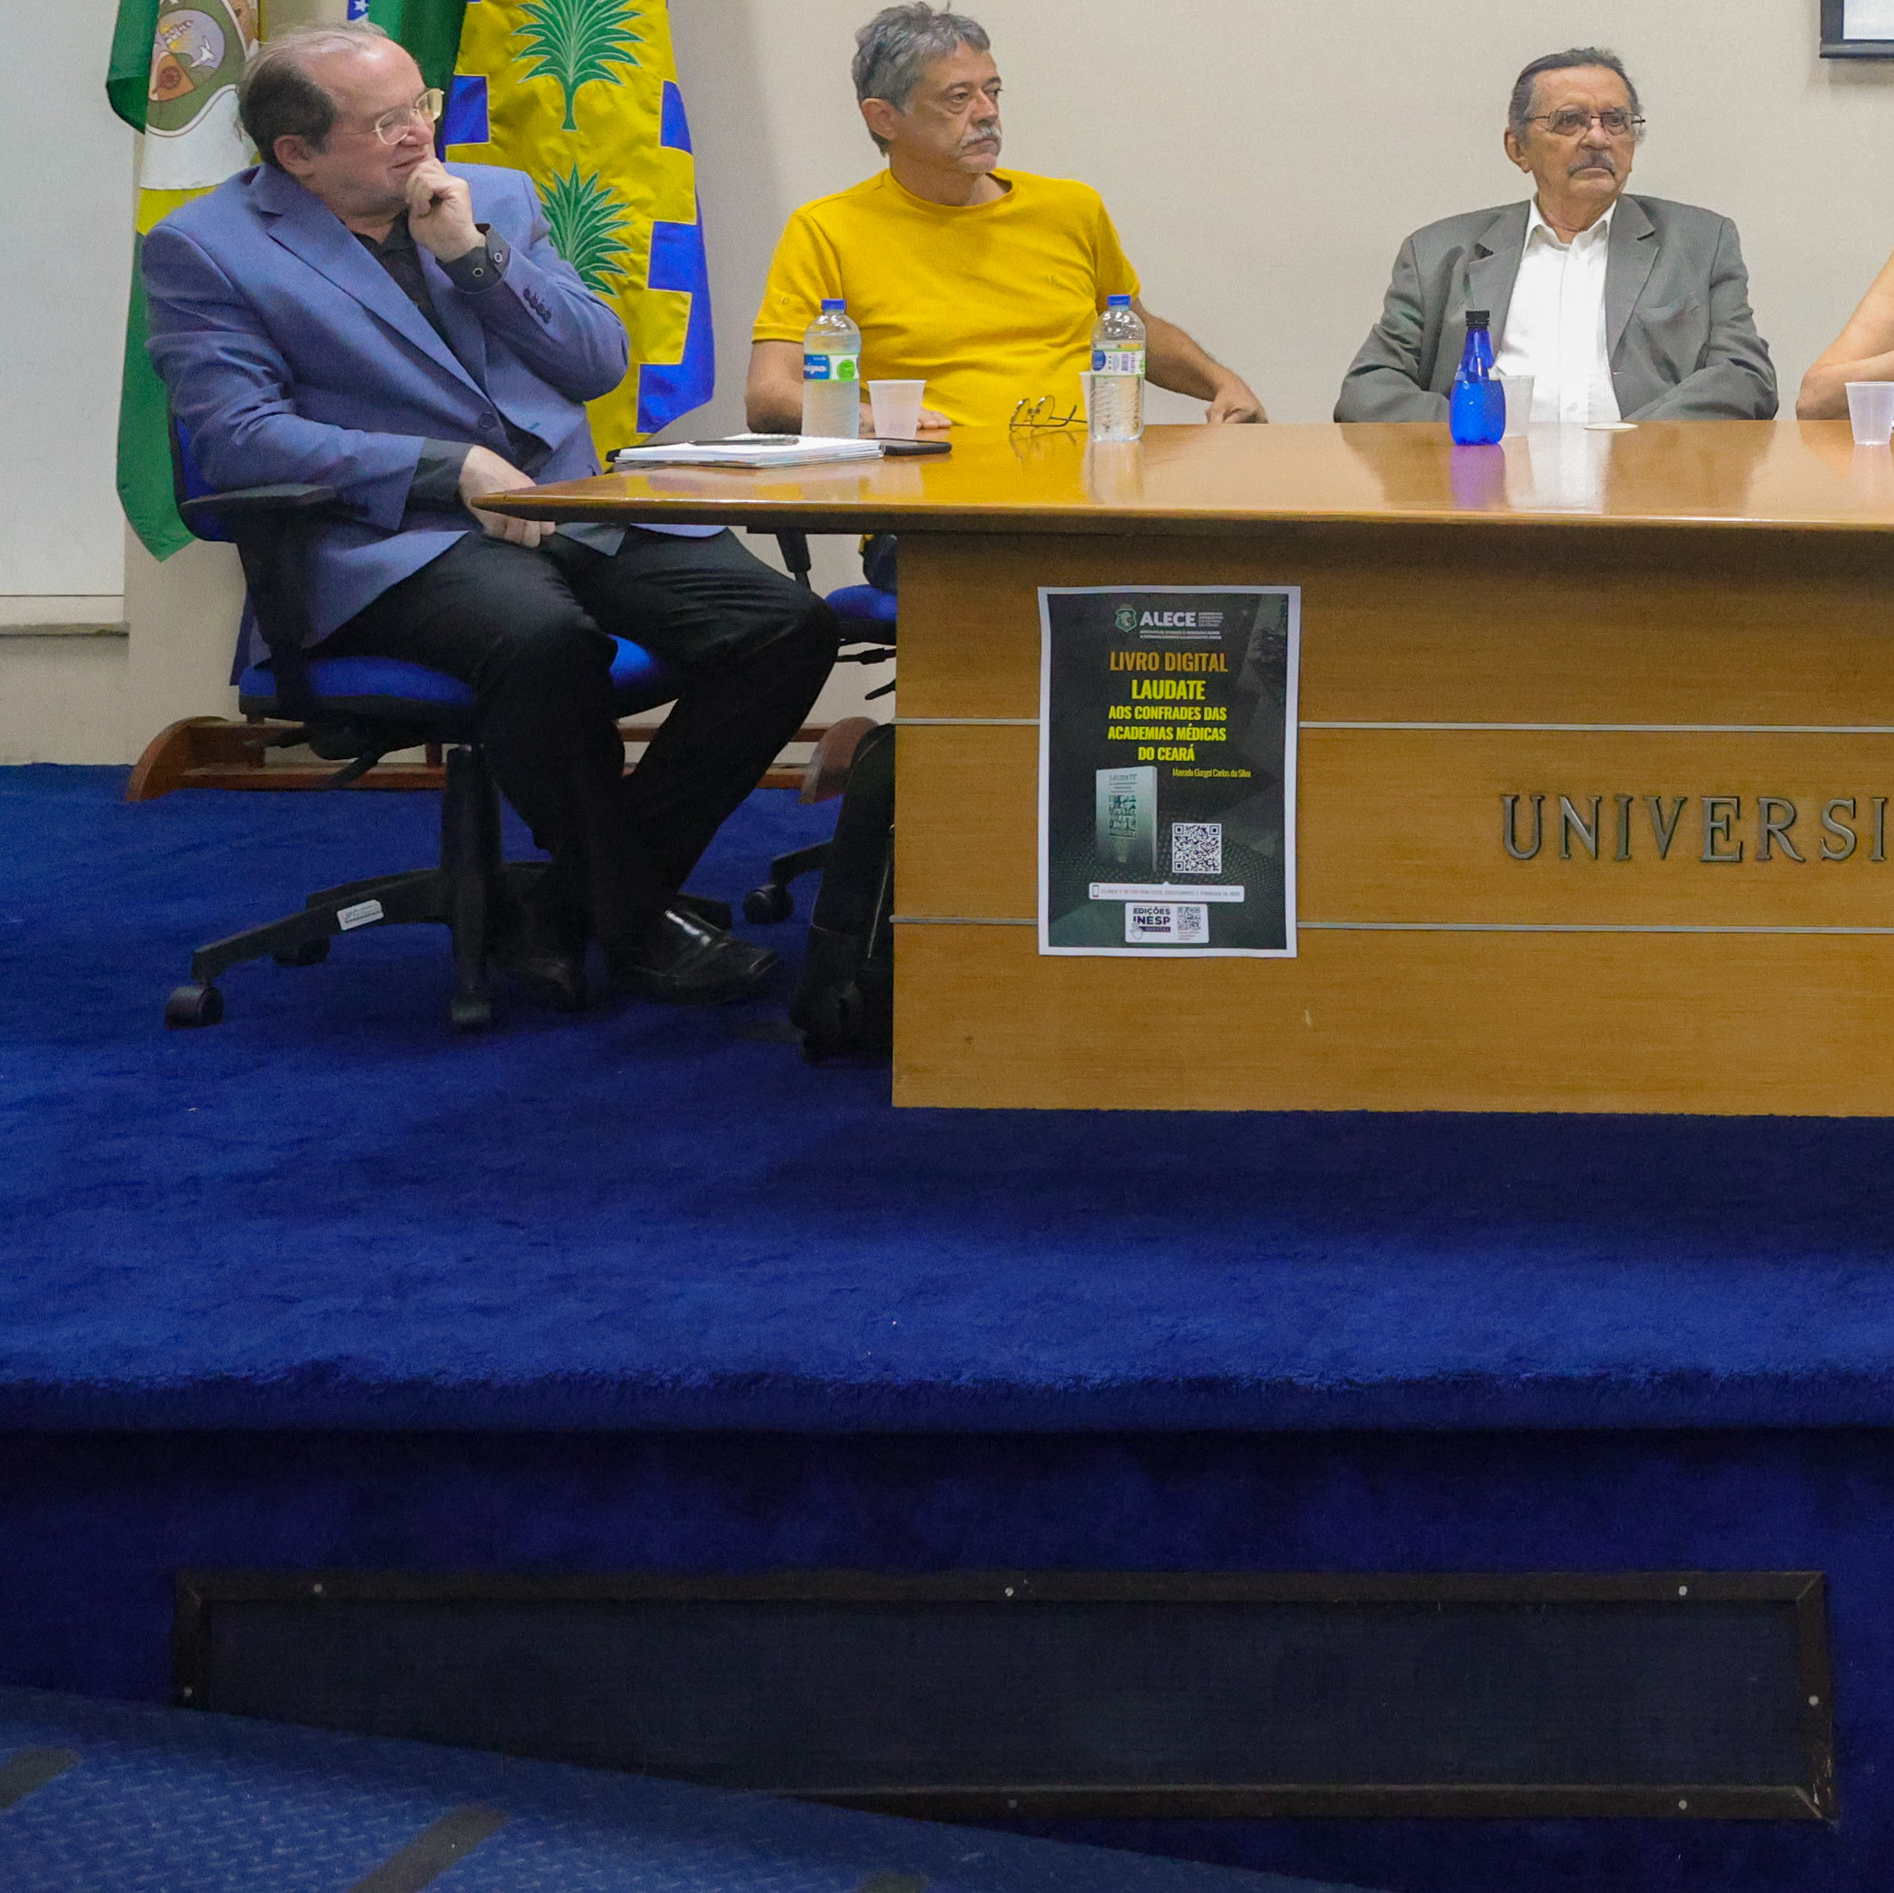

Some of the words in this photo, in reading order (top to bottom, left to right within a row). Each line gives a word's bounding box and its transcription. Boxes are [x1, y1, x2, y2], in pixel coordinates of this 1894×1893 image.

[1140, 610, 1197, 627] ALECE
[1109, 651, 1161, 672] LIVRO
[1164, 652, 1229, 673] DIGITAL
[1131, 679, 1207, 700] LAUDATE
[1108, 705, 1132, 720] AOS
[1134, 705, 1202, 721] CONFRADES
[1203, 706, 1228, 721] DAS
[1107, 726, 1174, 741] ACADEMIAS
[1175, 722, 1227, 742] MÉDICAS
[1137, 746, 1155, 761] DO
[1157, 743, 1196, 762] CEARÁ
[1132, 906, 1171, 916] EDIÇÕES
[1132, 915, 1171, 926] INESP
